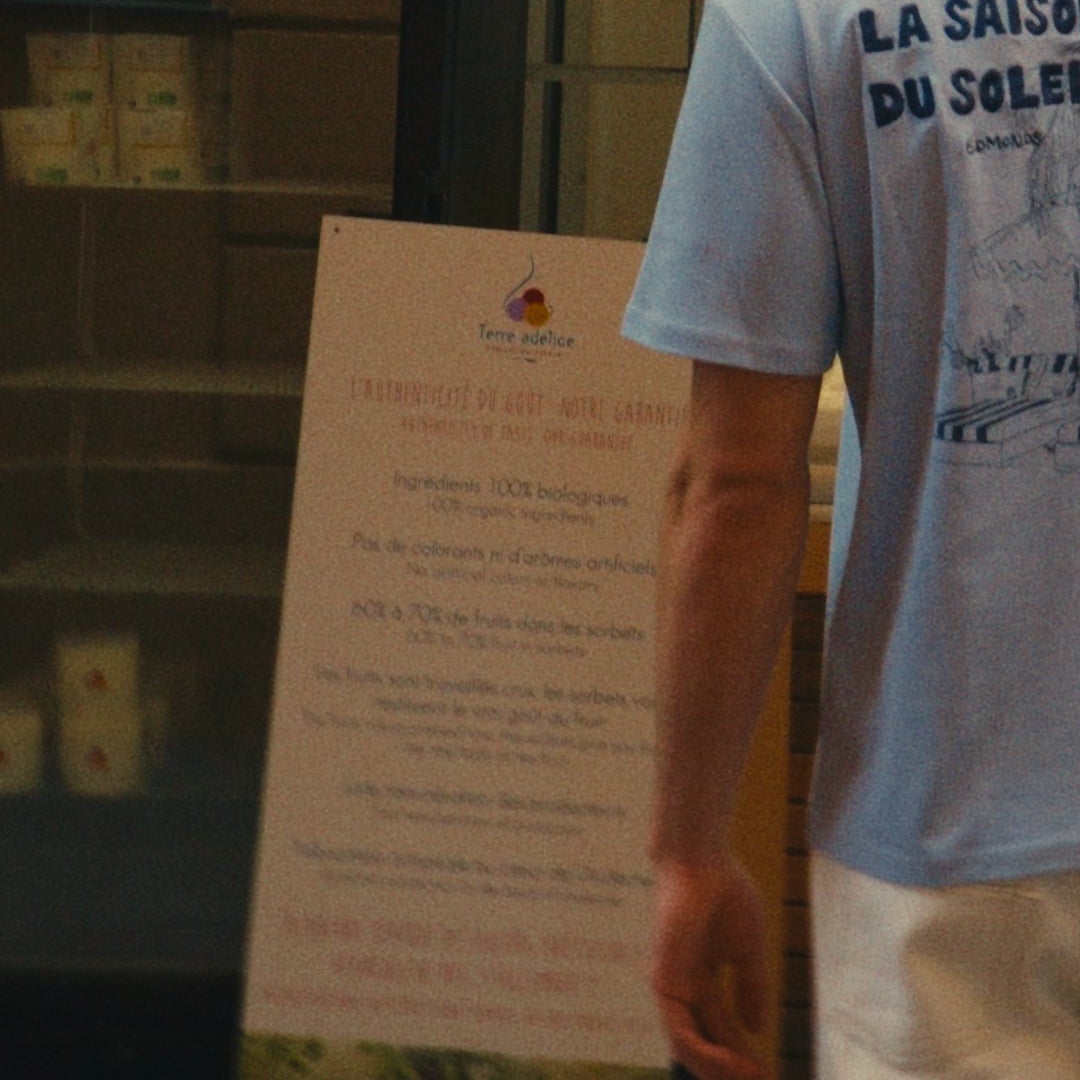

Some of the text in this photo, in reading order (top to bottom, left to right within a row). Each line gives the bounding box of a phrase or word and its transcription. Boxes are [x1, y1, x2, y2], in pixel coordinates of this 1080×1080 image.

[860, 4, 930, 53] LA
[868, 76, 937, 129] DU
[479, 323, 516, 344] Terre
[489, 476, 532, 498] 100%
[537, 481, 629, 508] biologiques
